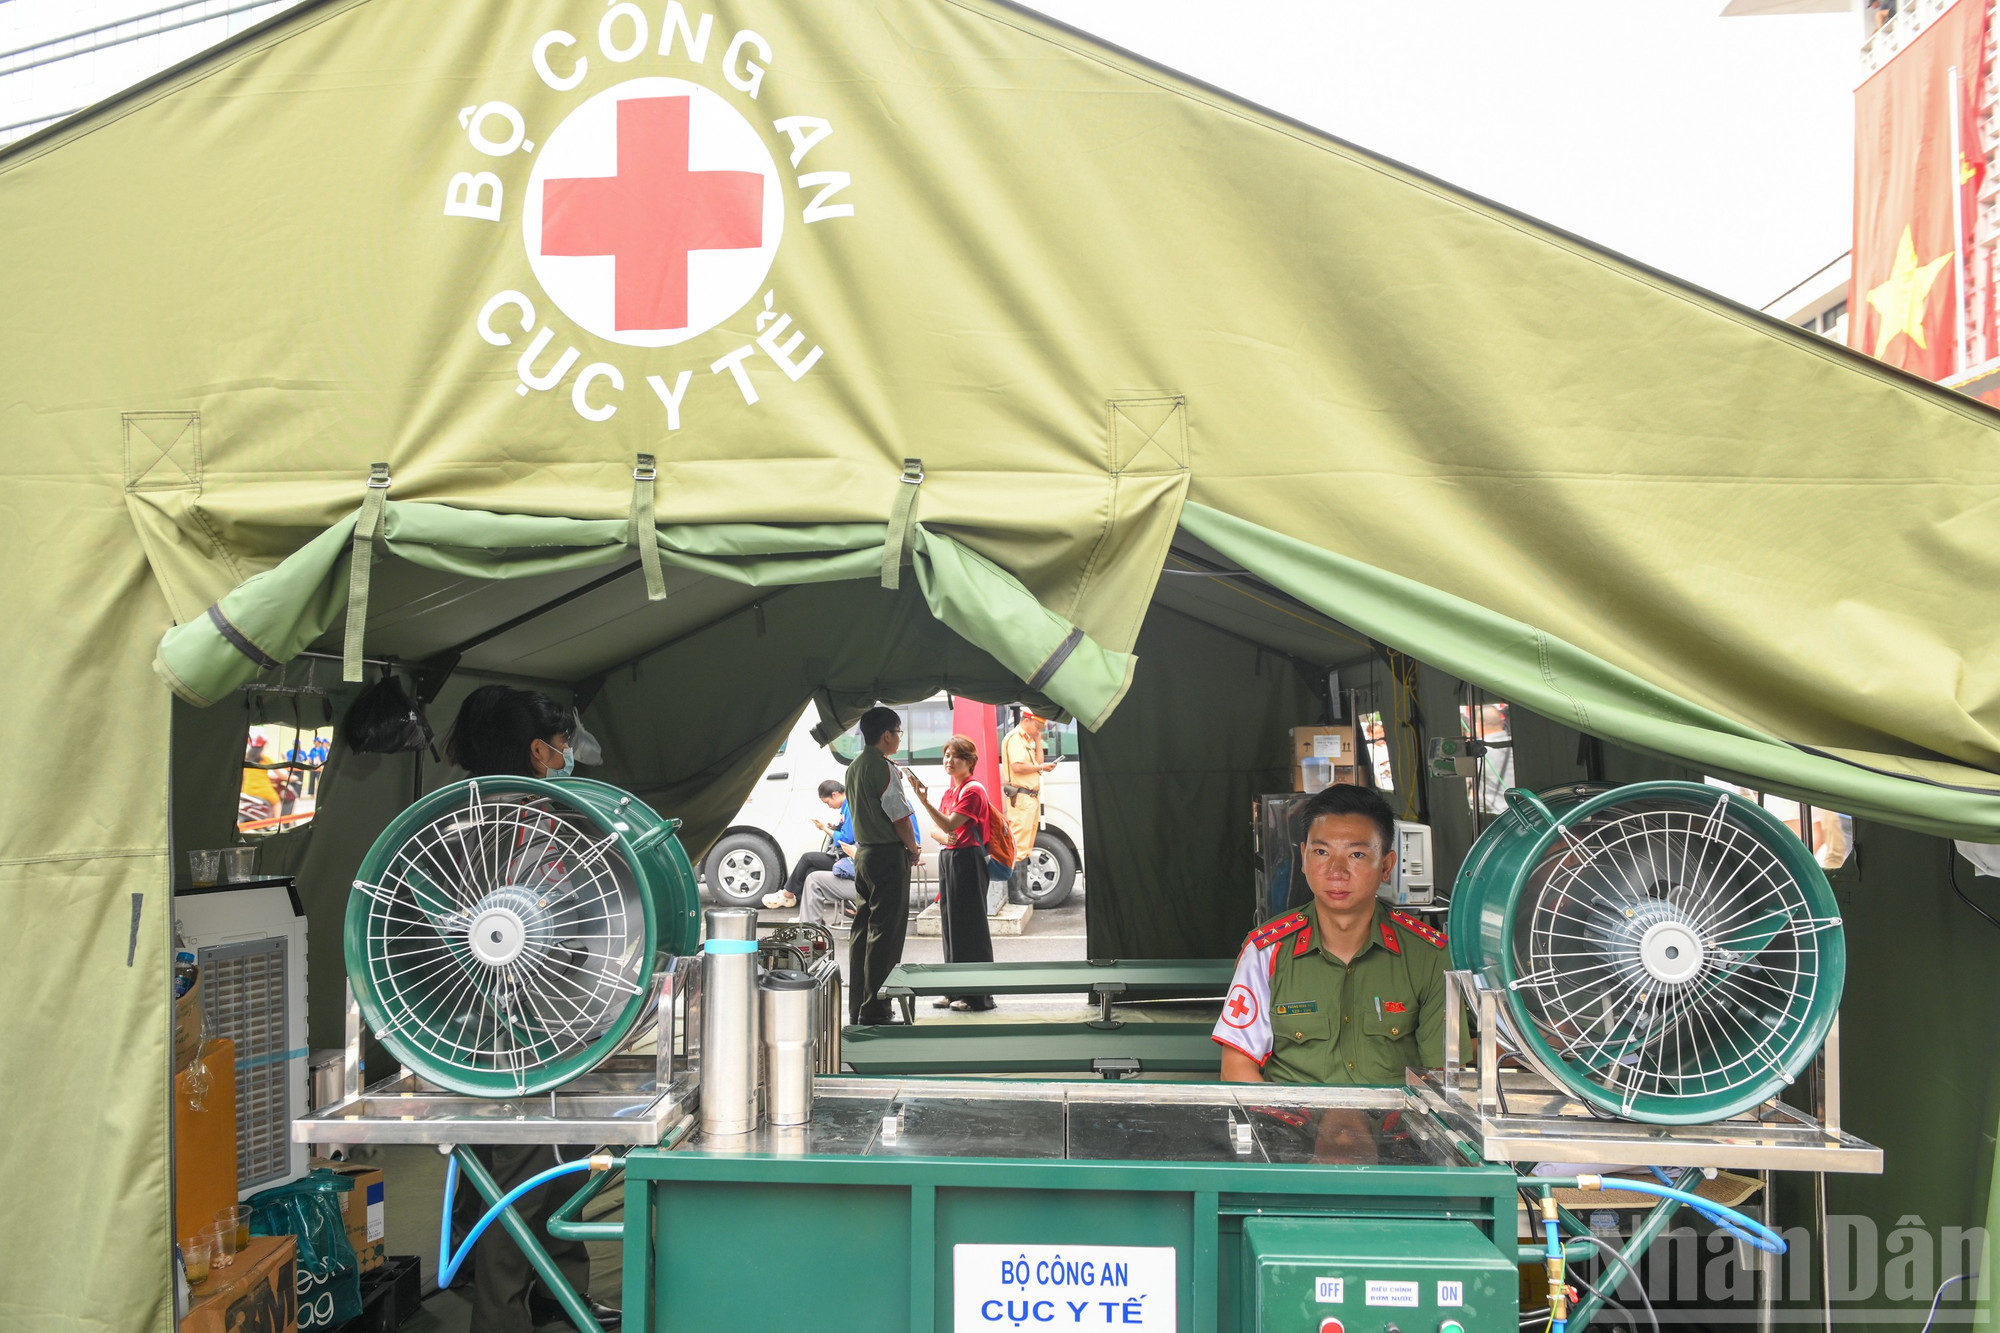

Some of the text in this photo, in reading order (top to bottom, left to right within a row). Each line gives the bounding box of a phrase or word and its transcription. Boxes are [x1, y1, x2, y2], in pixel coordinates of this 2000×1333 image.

[443, 0, 855, 224] BỘ CÔNG AN
[477, 289, 824, 430] CỤC Y TẾ
[1001, 1254, 1128, 1292] BỘ CÔNG AN
[1320, 1282, 1340, 1298] OFF
[981, 1294, 1147, 1327] CỤC Y TẾ
[1441, 1285, 1458, 1301] ON
